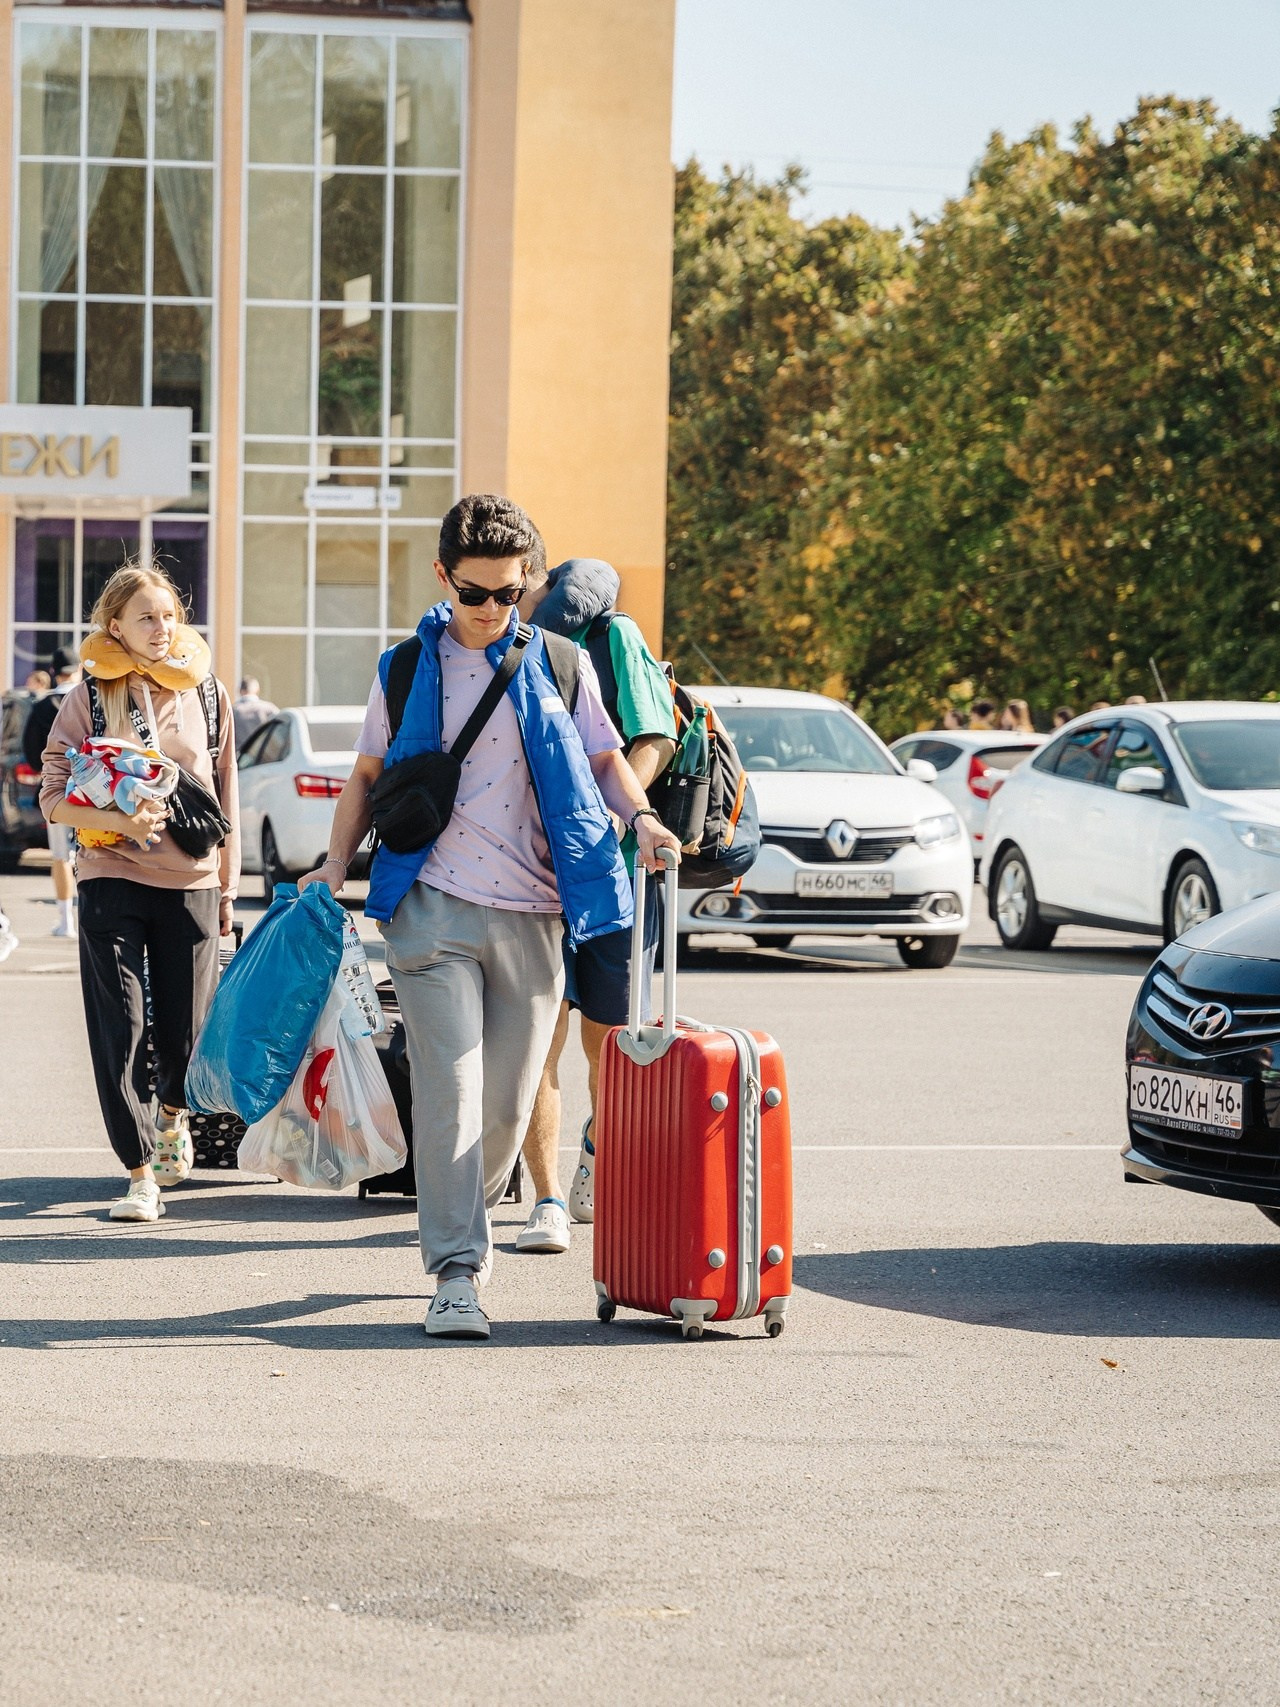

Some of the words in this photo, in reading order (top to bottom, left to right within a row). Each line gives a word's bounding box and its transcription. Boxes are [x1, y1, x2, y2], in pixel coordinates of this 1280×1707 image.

[129, 708, 149, 733] SEE
[802, 874, 867, 891] Н660МС
[1137, 1075, 1208, 1120] О820КН
[1215, 1084, 1235, 1113] 46
[1214, 1113, 1230, 1125] RUS
